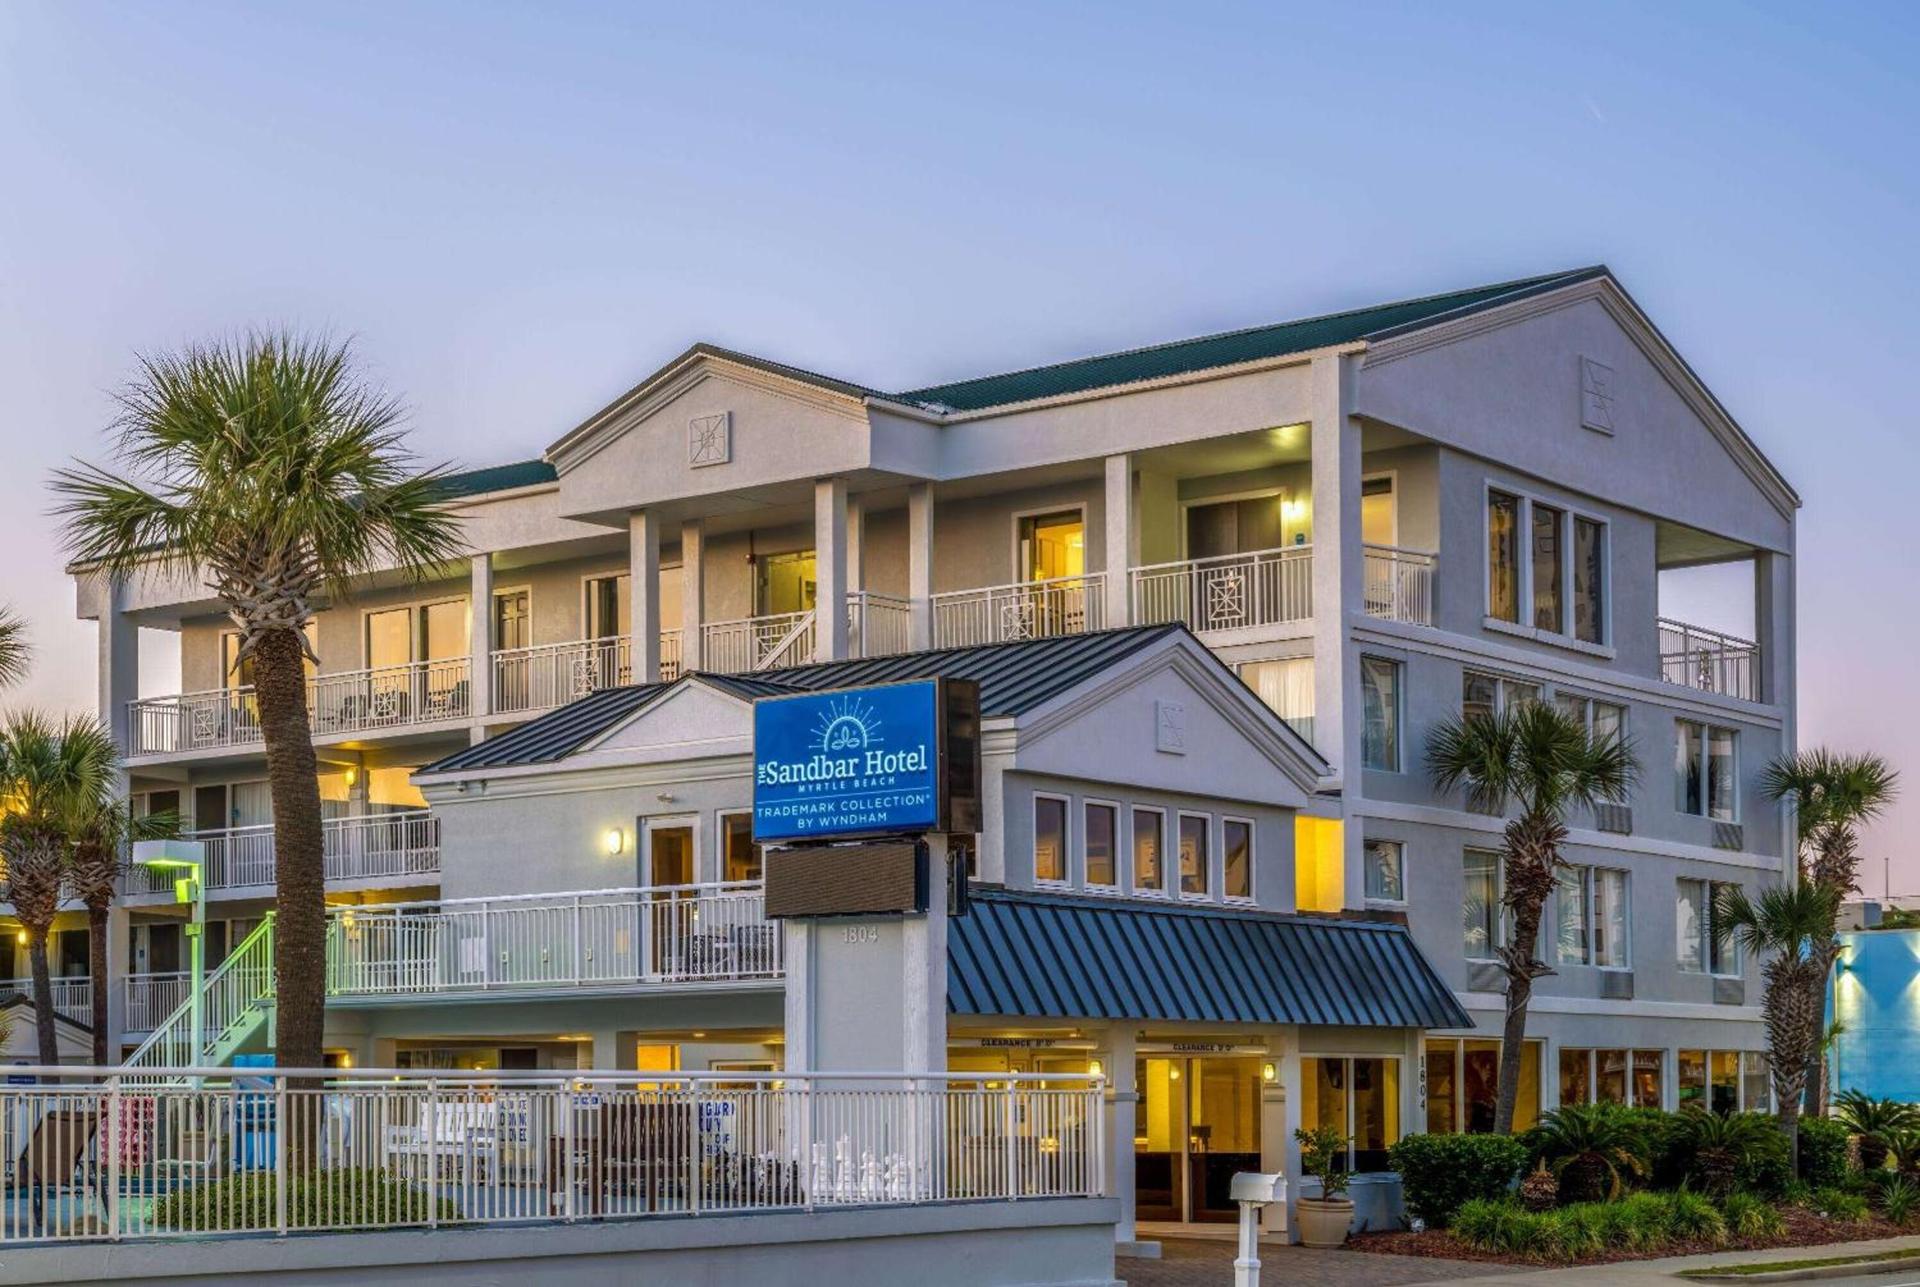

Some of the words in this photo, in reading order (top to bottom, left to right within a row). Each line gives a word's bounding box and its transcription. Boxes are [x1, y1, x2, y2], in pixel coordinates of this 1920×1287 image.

[766, 755, 859, 785] Sandbar
[864, 744, 928, 776] Hotel
[757, 763, 766, 785] THE
[798, 781, 846, 793] MYRTLE
[854, 775, 895, 788] BEACH
[757, 801, 836, 818] TRADEMARK
[797, 818, 814, 829] BY
[819, 812, 887, 827] WYNDHAM
[842, 926, 878, 943] 1804
